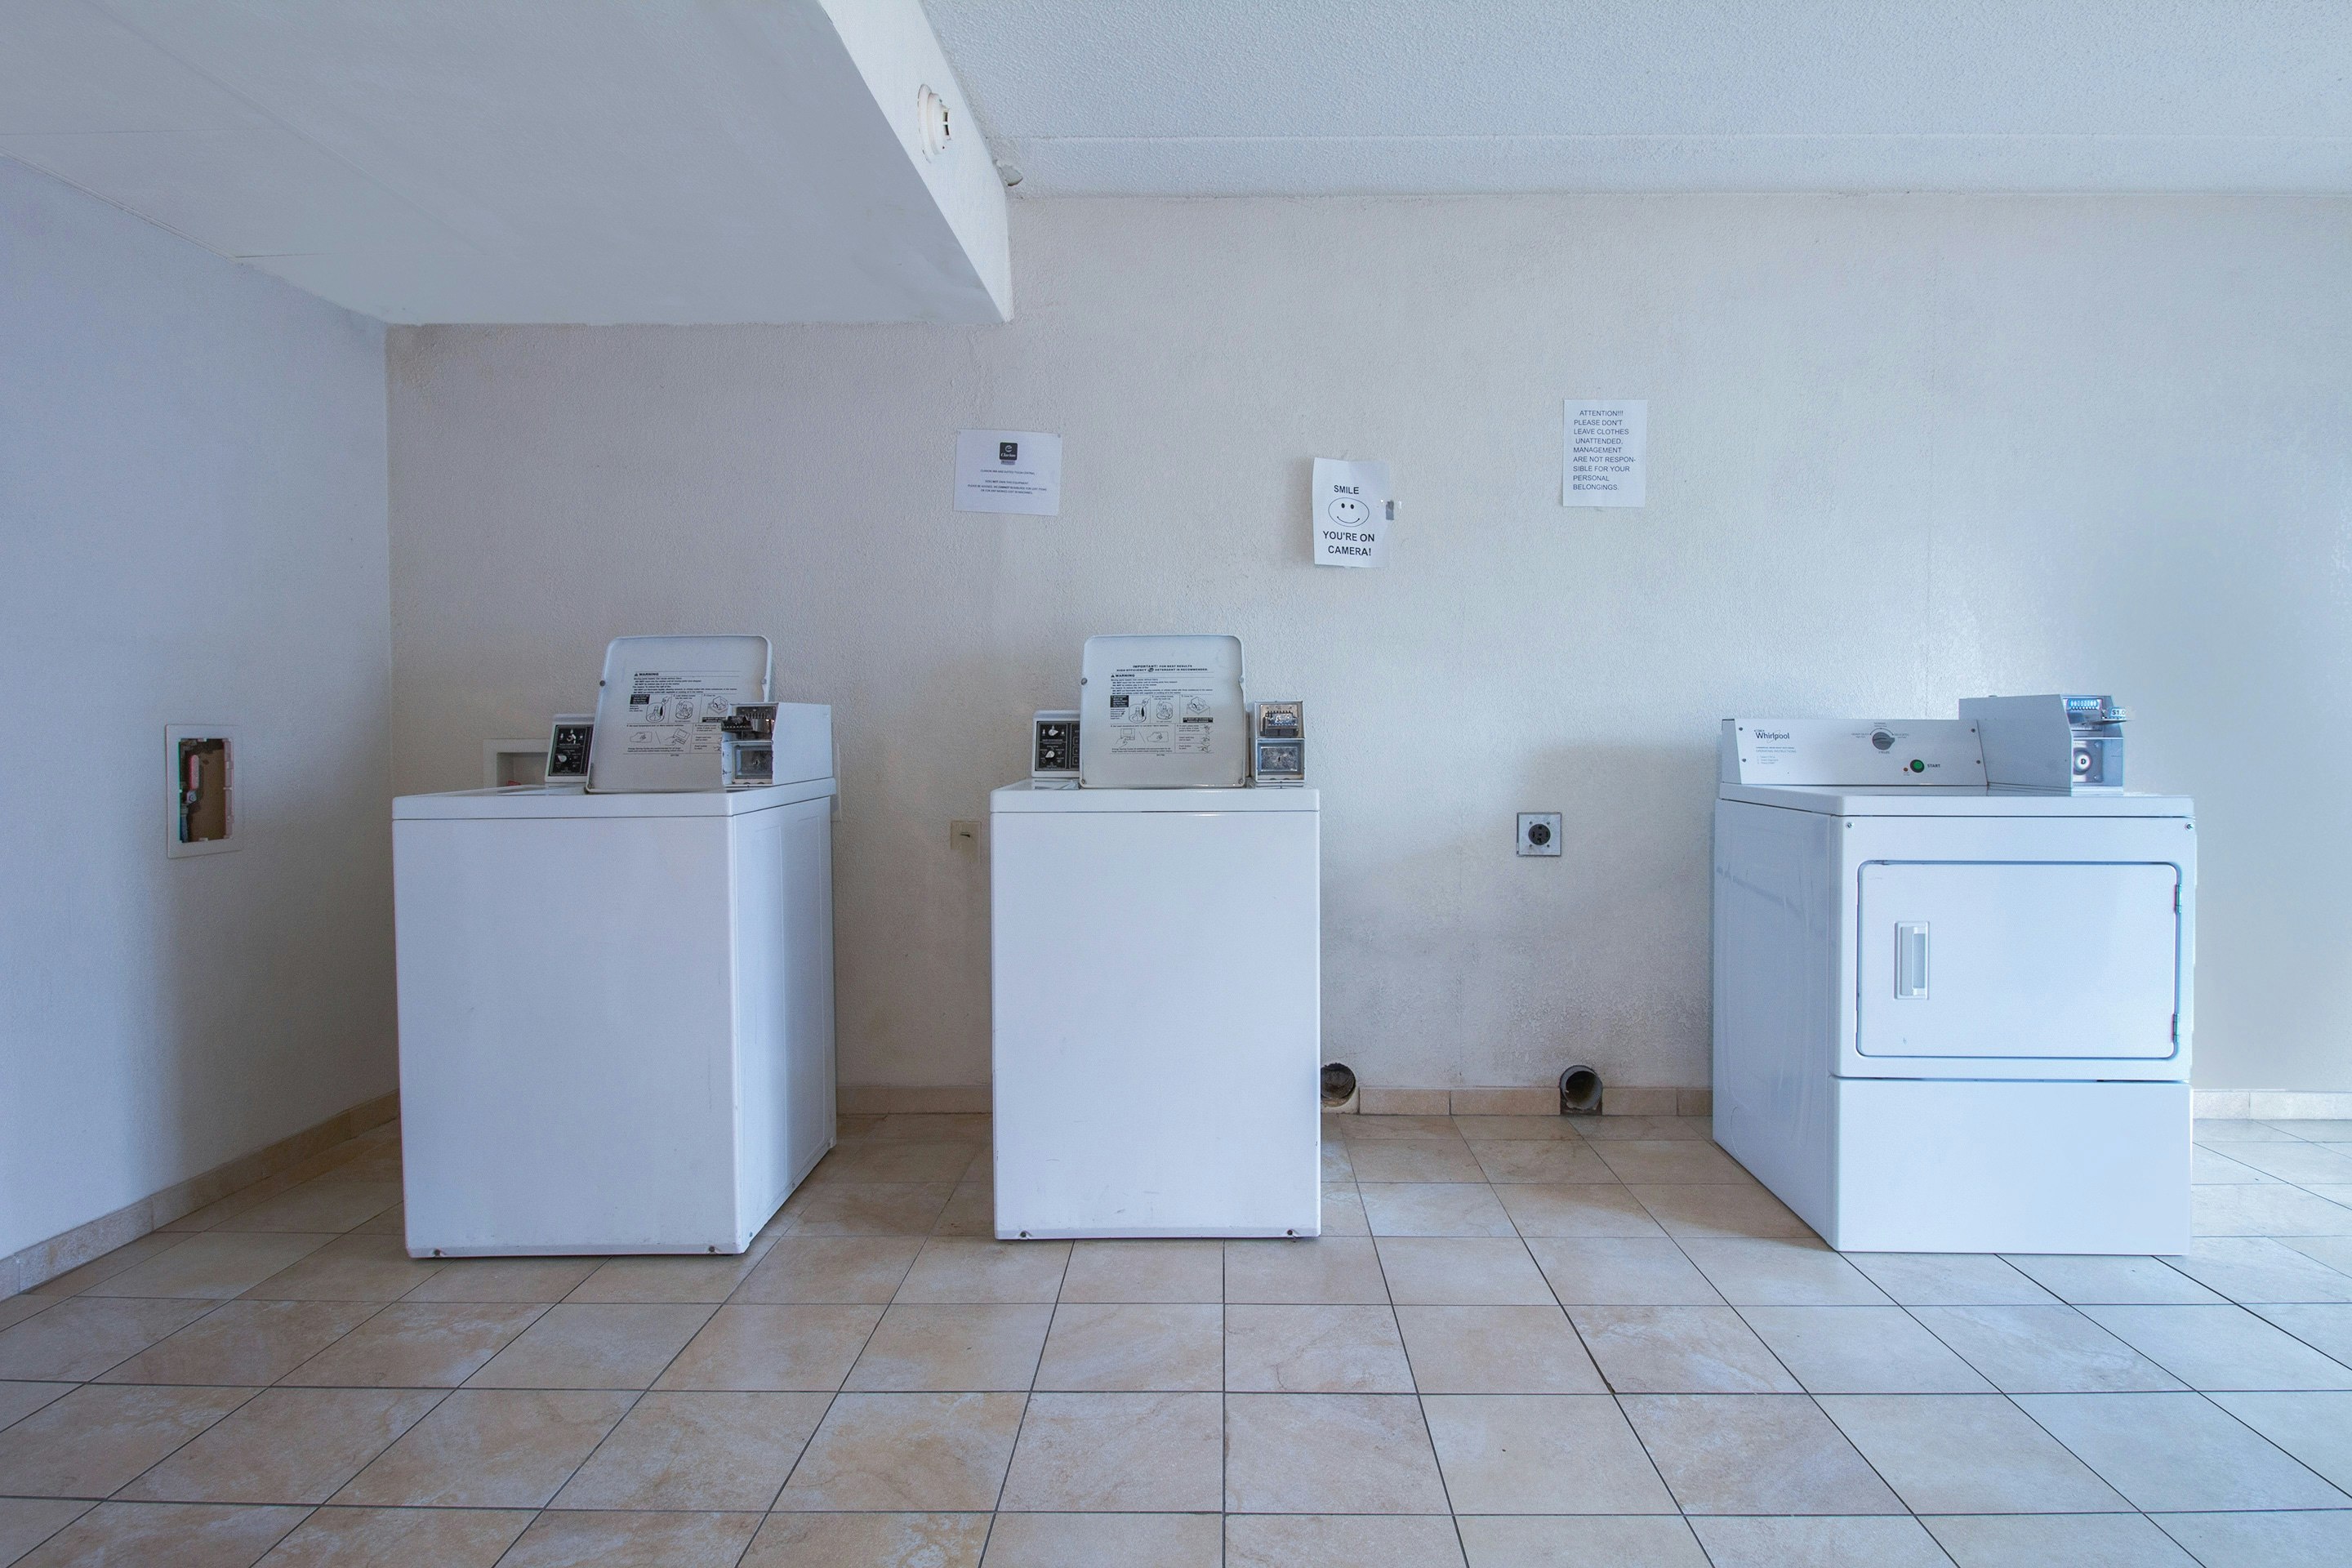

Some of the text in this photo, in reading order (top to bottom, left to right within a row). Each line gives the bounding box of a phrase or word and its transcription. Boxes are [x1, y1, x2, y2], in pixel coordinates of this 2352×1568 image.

[1334, 484, 1360, 494] SMILE
[1323, 531, 1375, 542] YOU'RE ON
[1328, 545, 1372, 556] CAMERA!
[1755, 732, 1790, 741] Whirlpool
